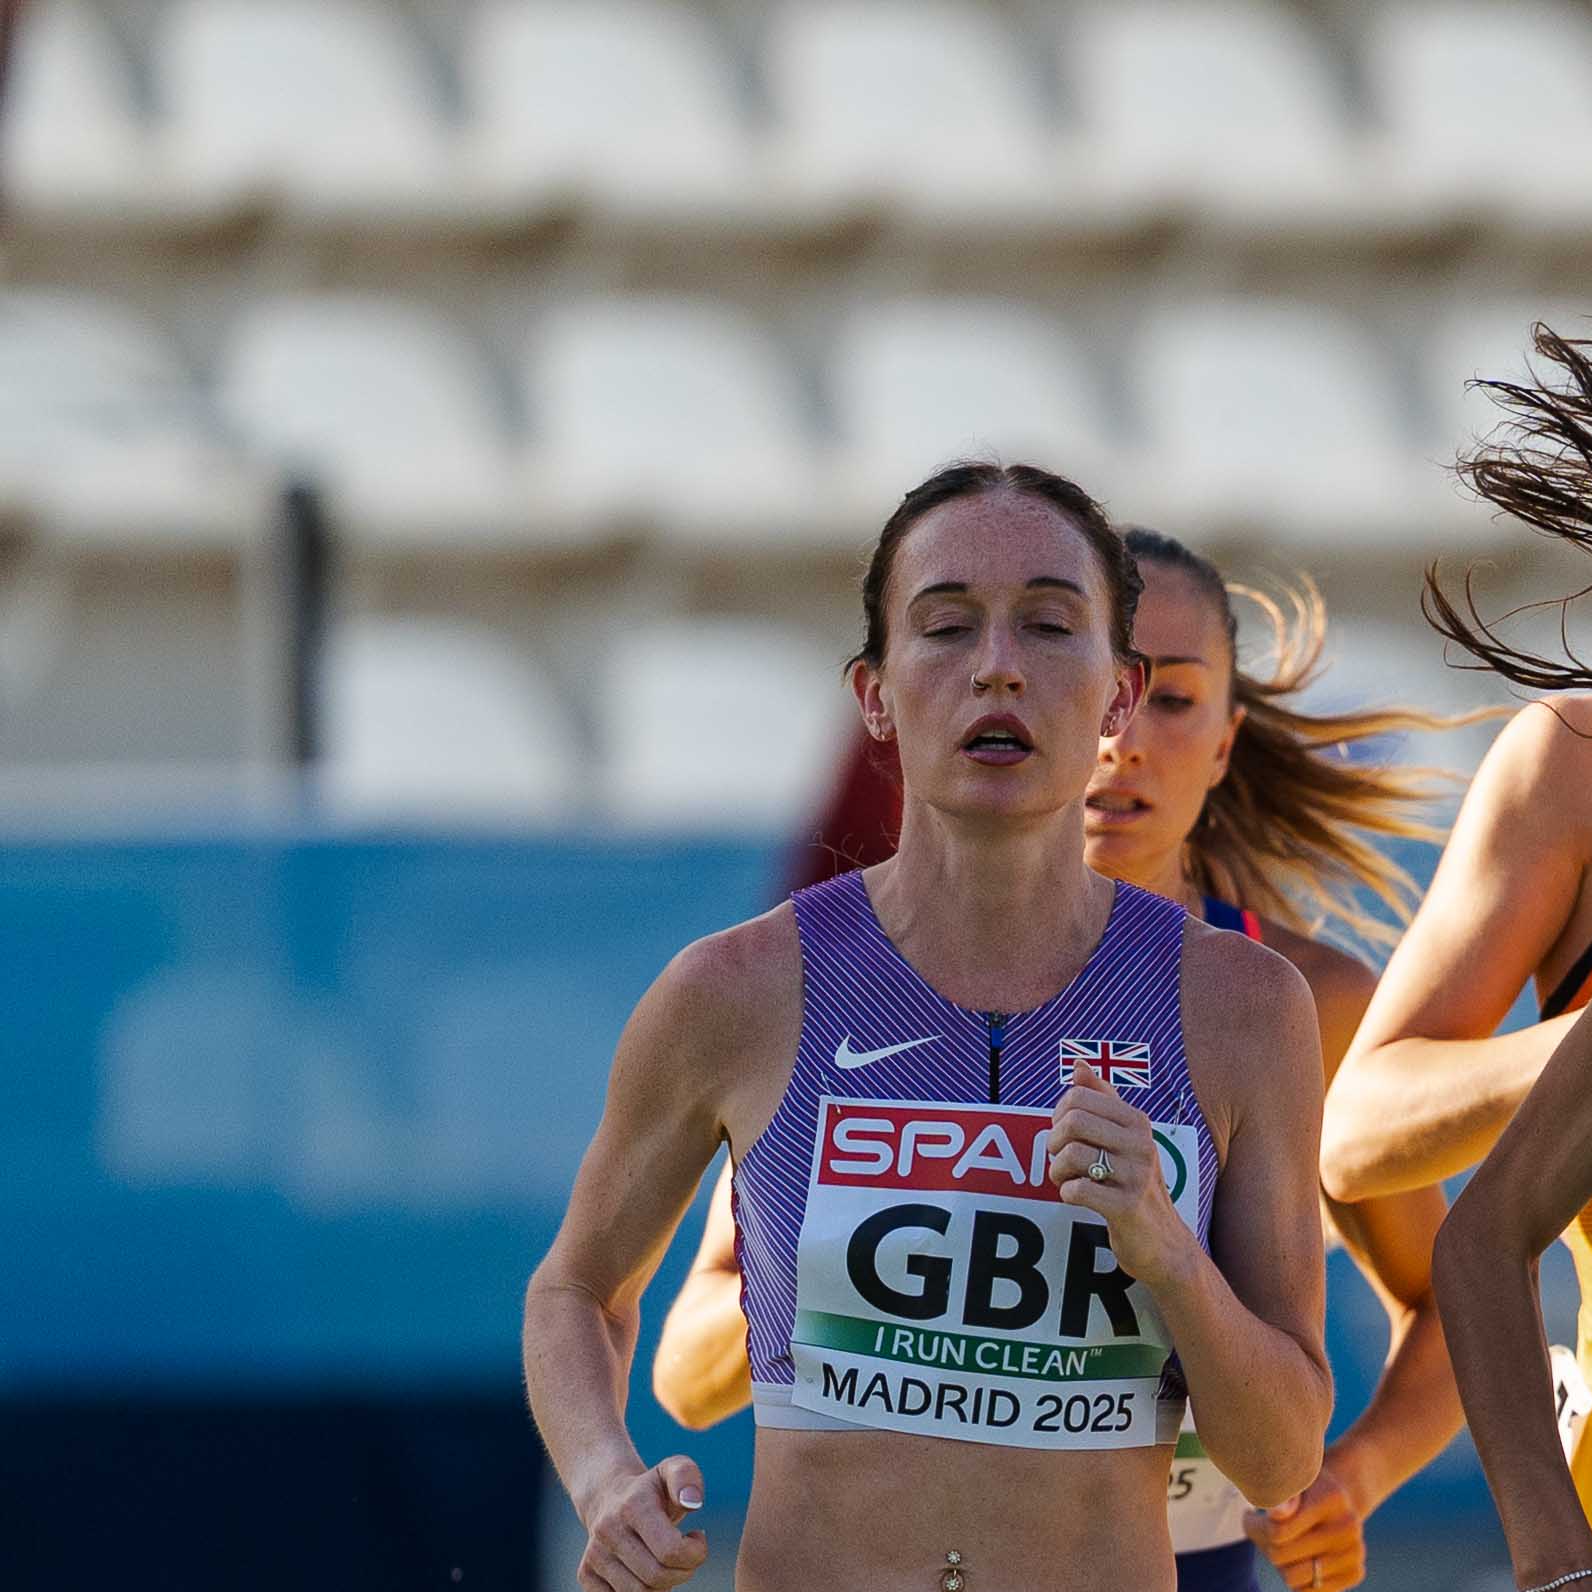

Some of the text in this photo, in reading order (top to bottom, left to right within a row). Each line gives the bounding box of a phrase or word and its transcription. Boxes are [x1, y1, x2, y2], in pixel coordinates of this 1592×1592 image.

[846, 1202, 1141, 1339] GBR
[873, 1325, 885, 1353] I
[891, 1329, 967, 1367] RUN
[821, 1362, 1136, 1433] MADRID 2025
